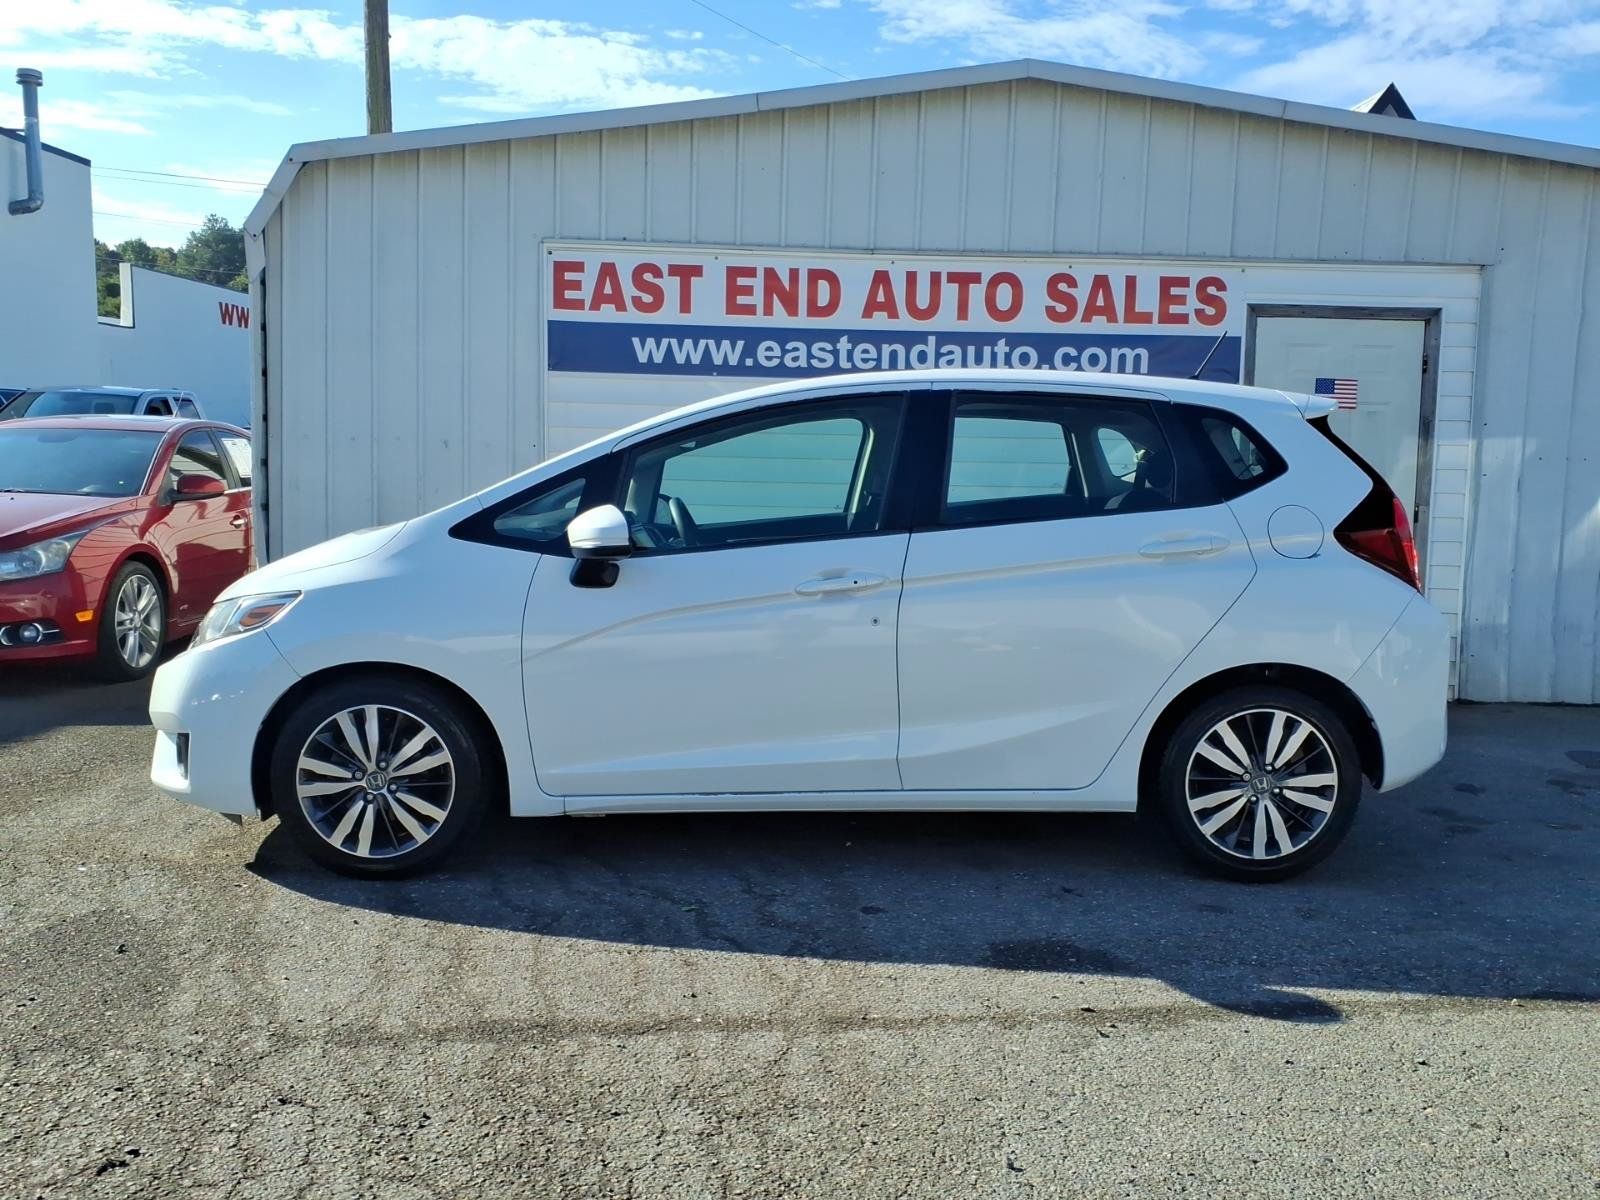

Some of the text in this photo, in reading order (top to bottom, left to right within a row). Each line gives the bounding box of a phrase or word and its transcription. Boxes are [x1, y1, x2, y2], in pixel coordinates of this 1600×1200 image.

[552, 260, 1228, 326] EAST END AUTO SALES
[632, 335, 1149, 374] www.eastendauto.com
